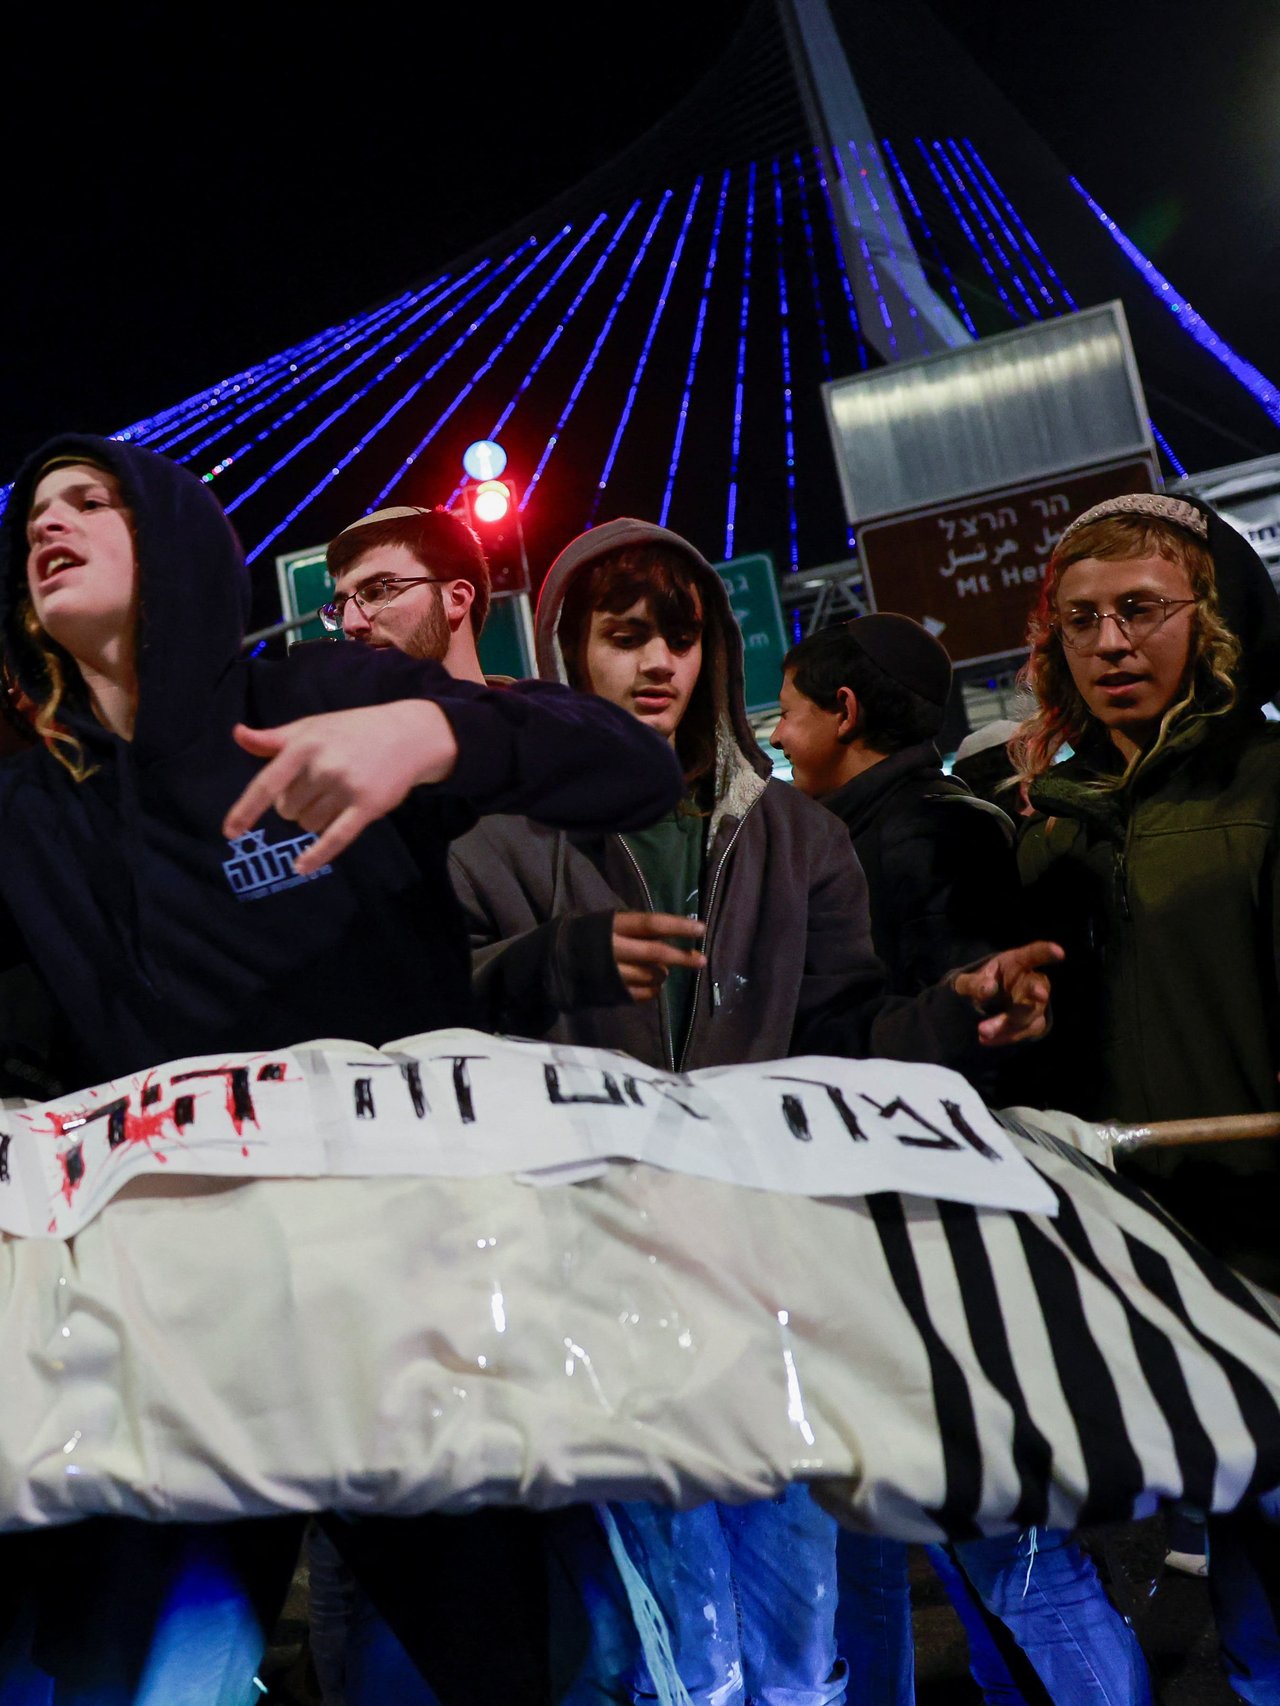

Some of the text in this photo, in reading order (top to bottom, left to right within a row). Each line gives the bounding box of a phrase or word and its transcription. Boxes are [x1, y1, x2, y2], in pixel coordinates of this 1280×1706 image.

[937, 493, 1070, 541] הר הרצל
[955, 562, 1047, 600] Mt Her
[346, 1055, 491, 1125] זה
